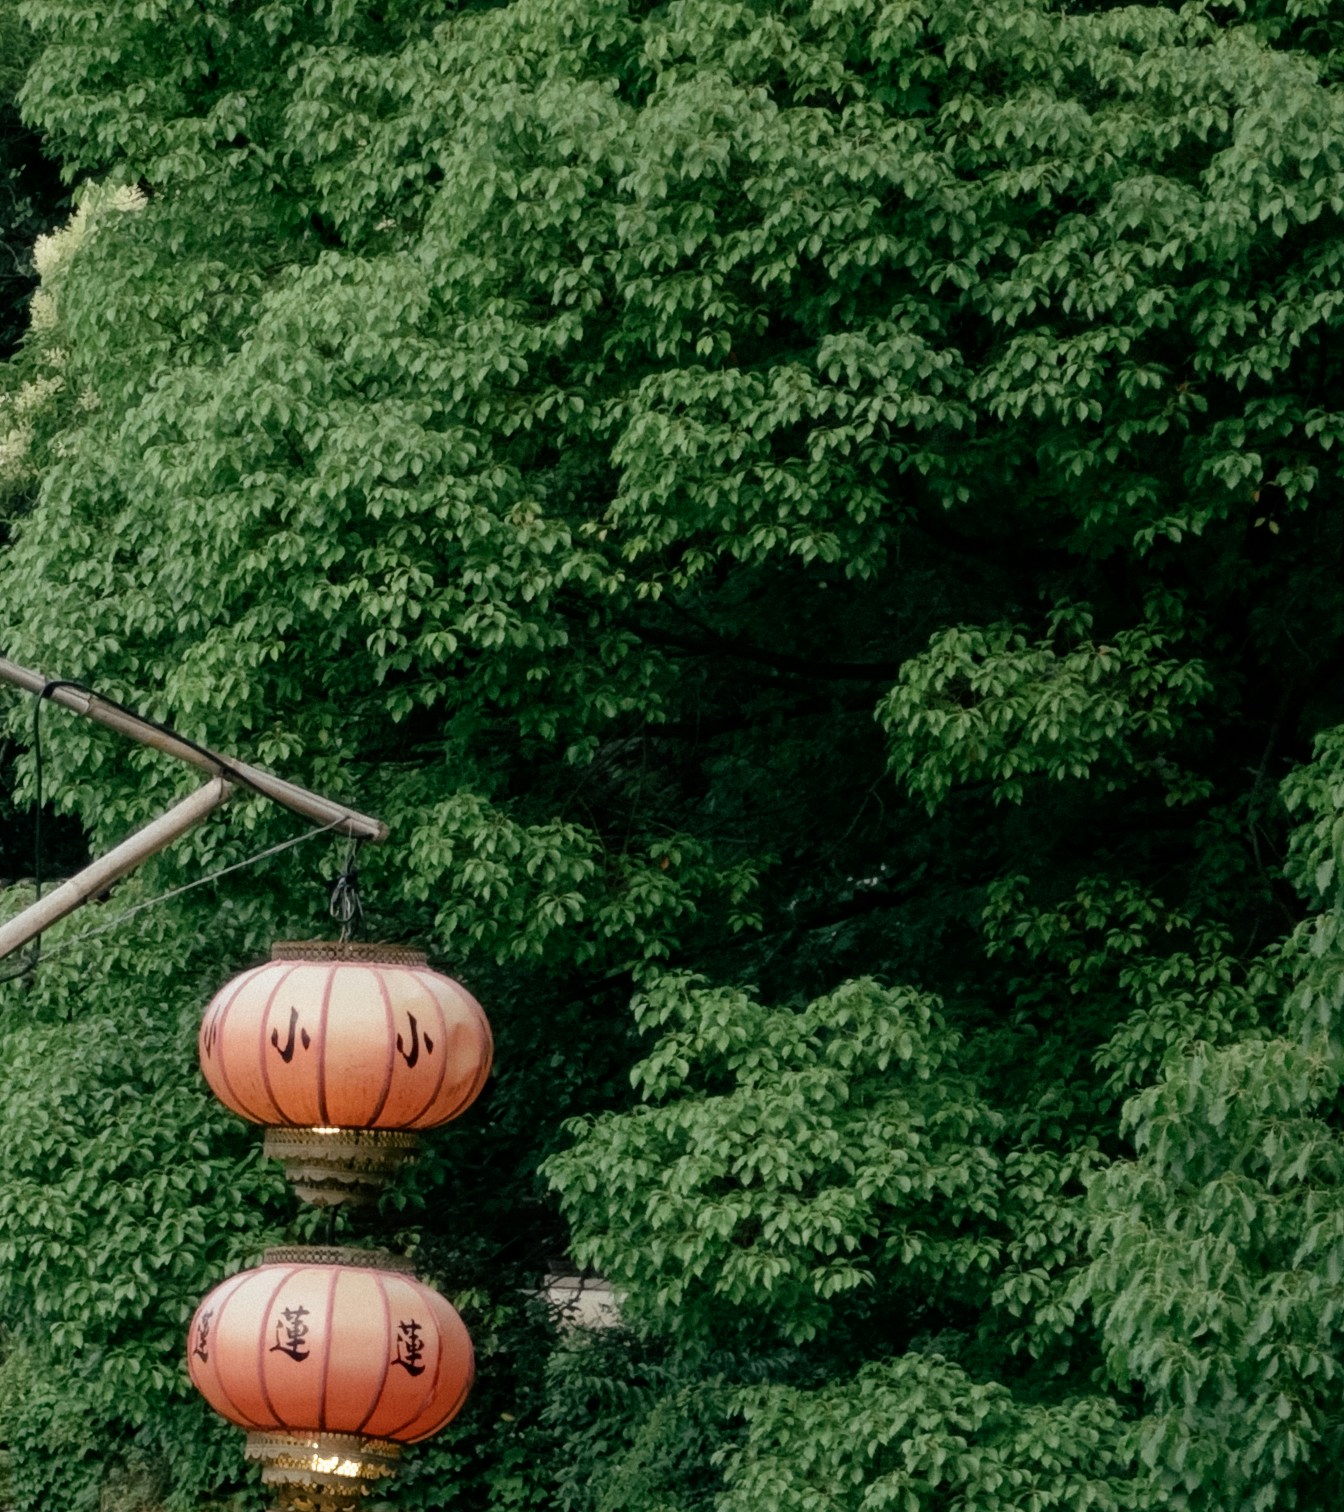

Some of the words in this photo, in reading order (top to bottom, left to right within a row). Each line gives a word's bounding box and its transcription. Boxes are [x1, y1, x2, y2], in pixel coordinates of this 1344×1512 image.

[270, 1006, 311, 1063] 小
[396, 1010, 434, 1068] 小
[269, 1305, 310, 1362] 蓮
[391, 1319, 426, 1377] 蓮
